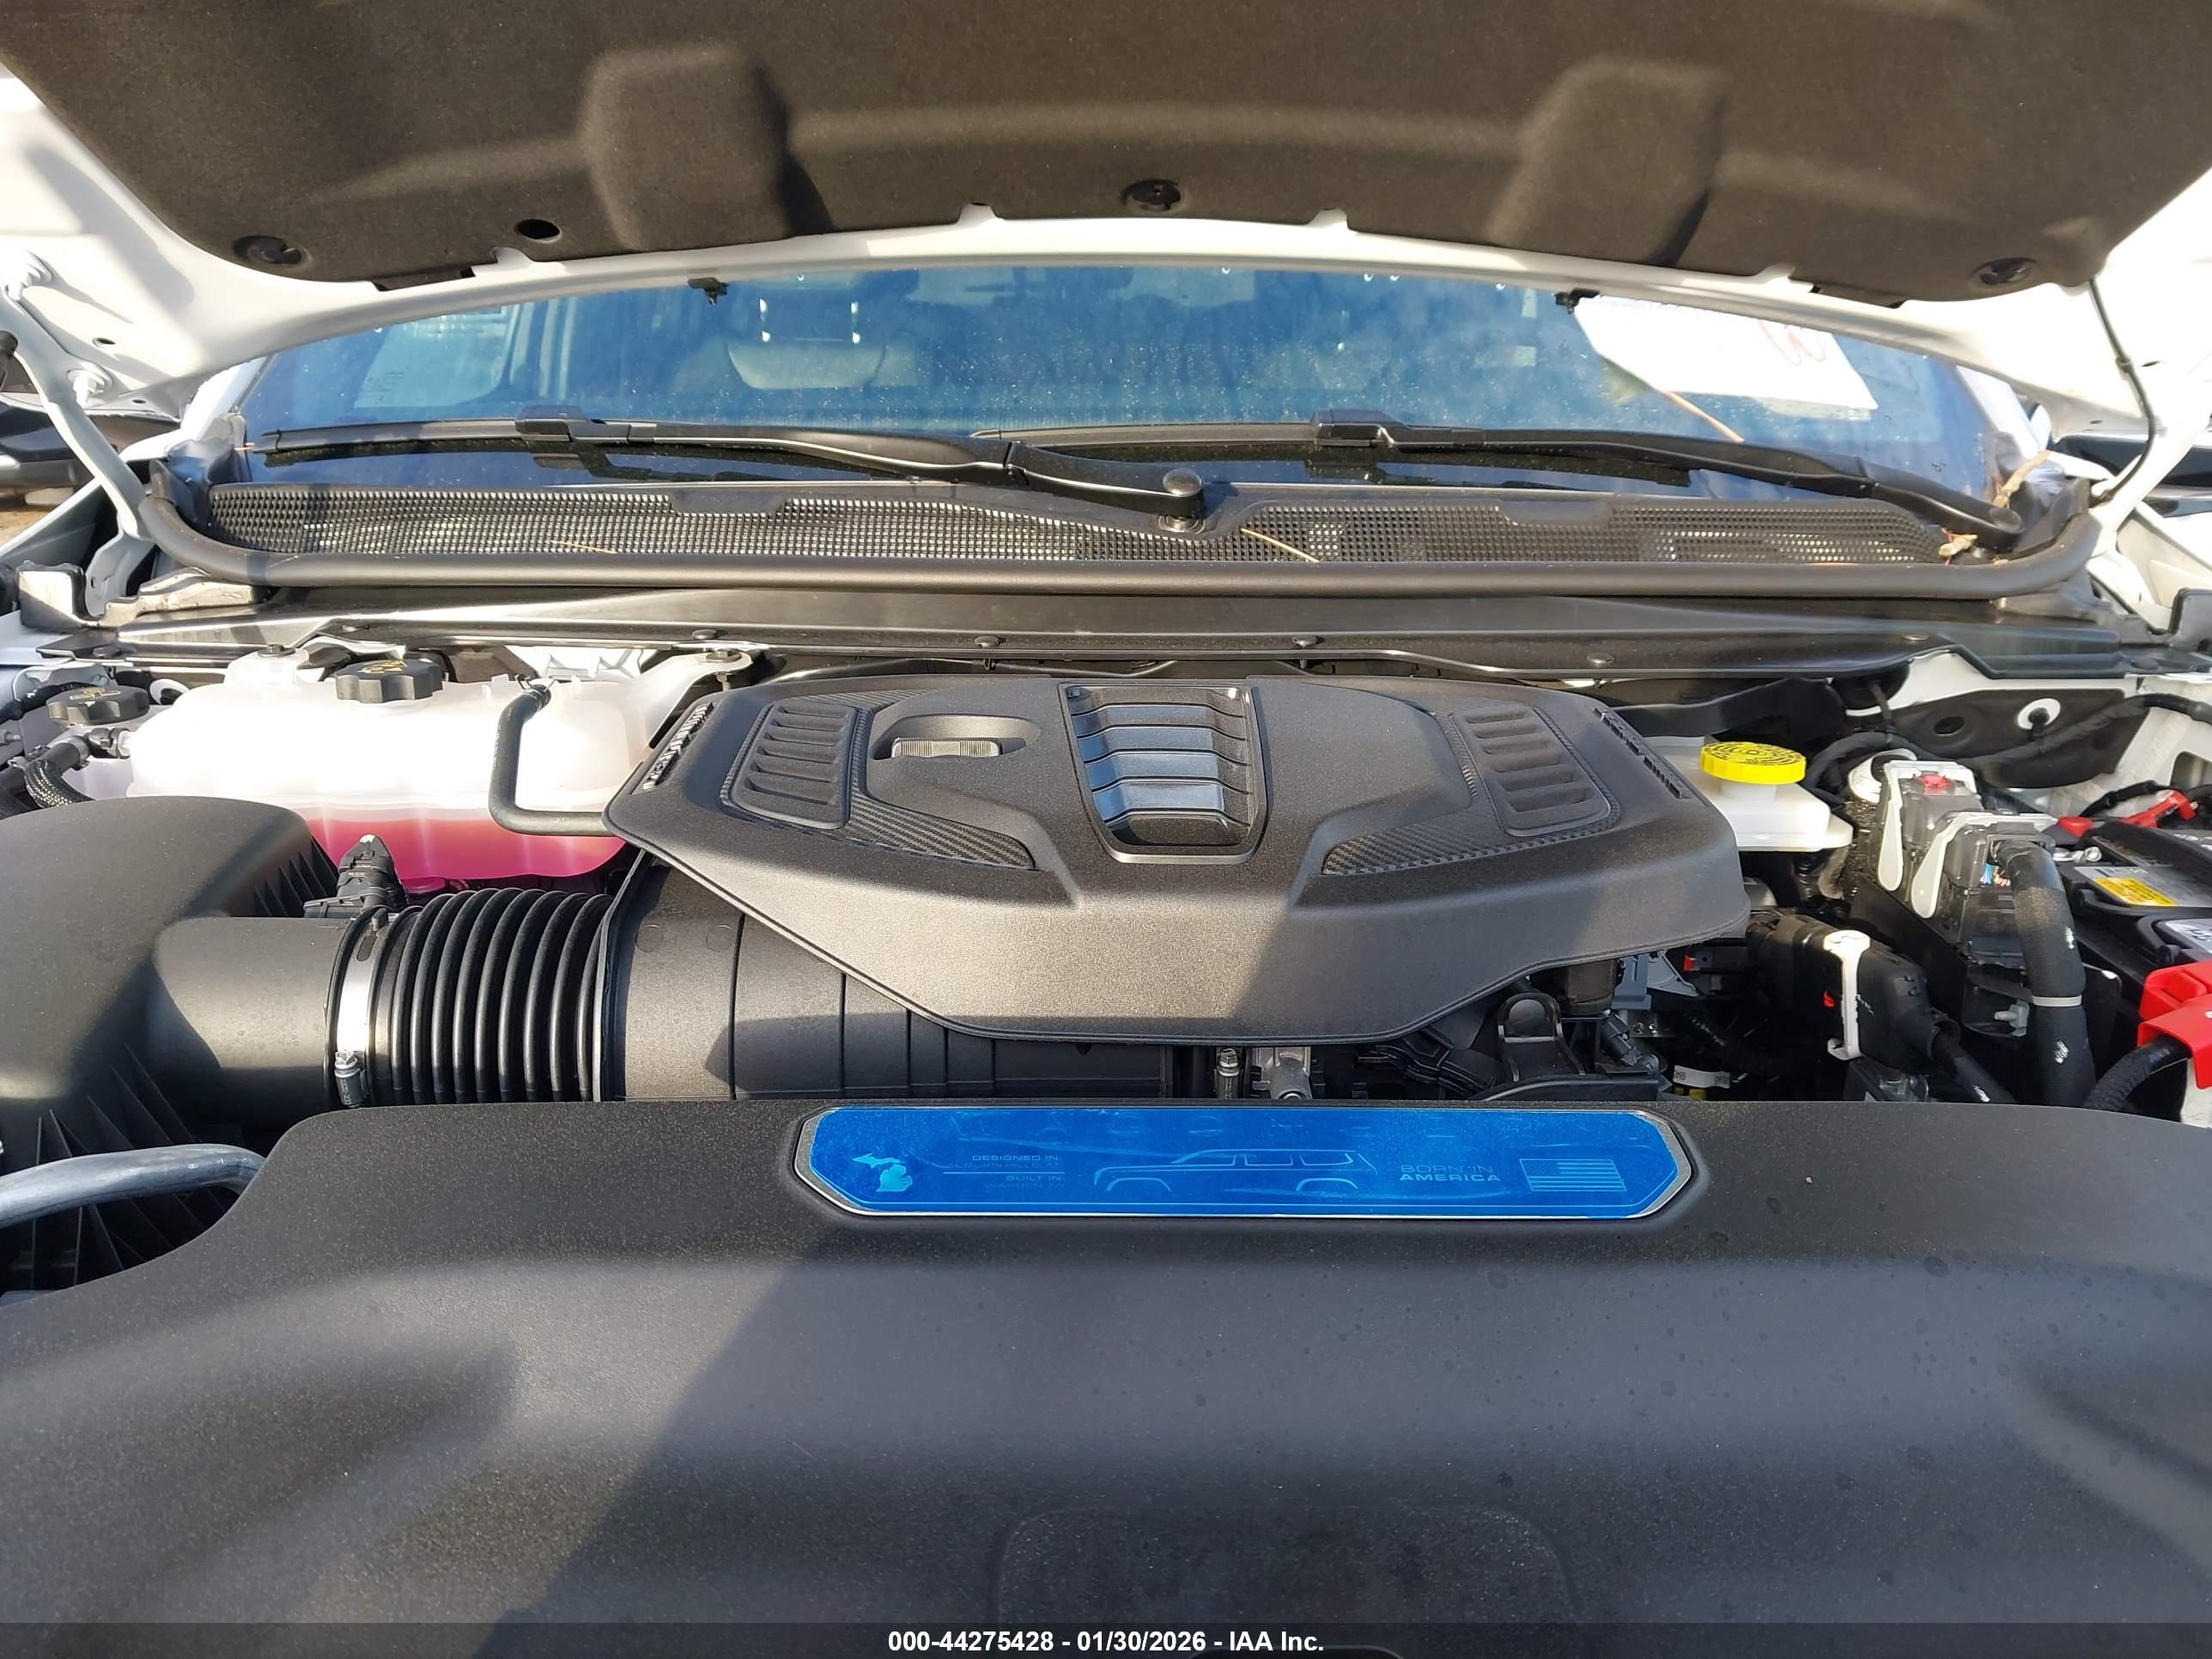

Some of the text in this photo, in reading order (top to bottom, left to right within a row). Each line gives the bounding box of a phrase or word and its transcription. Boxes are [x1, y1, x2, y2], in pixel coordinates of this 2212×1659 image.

[1401, 1164, 1493, 1173] BORN IN
[1399, 1173, 1501, 1182] AMERICA
